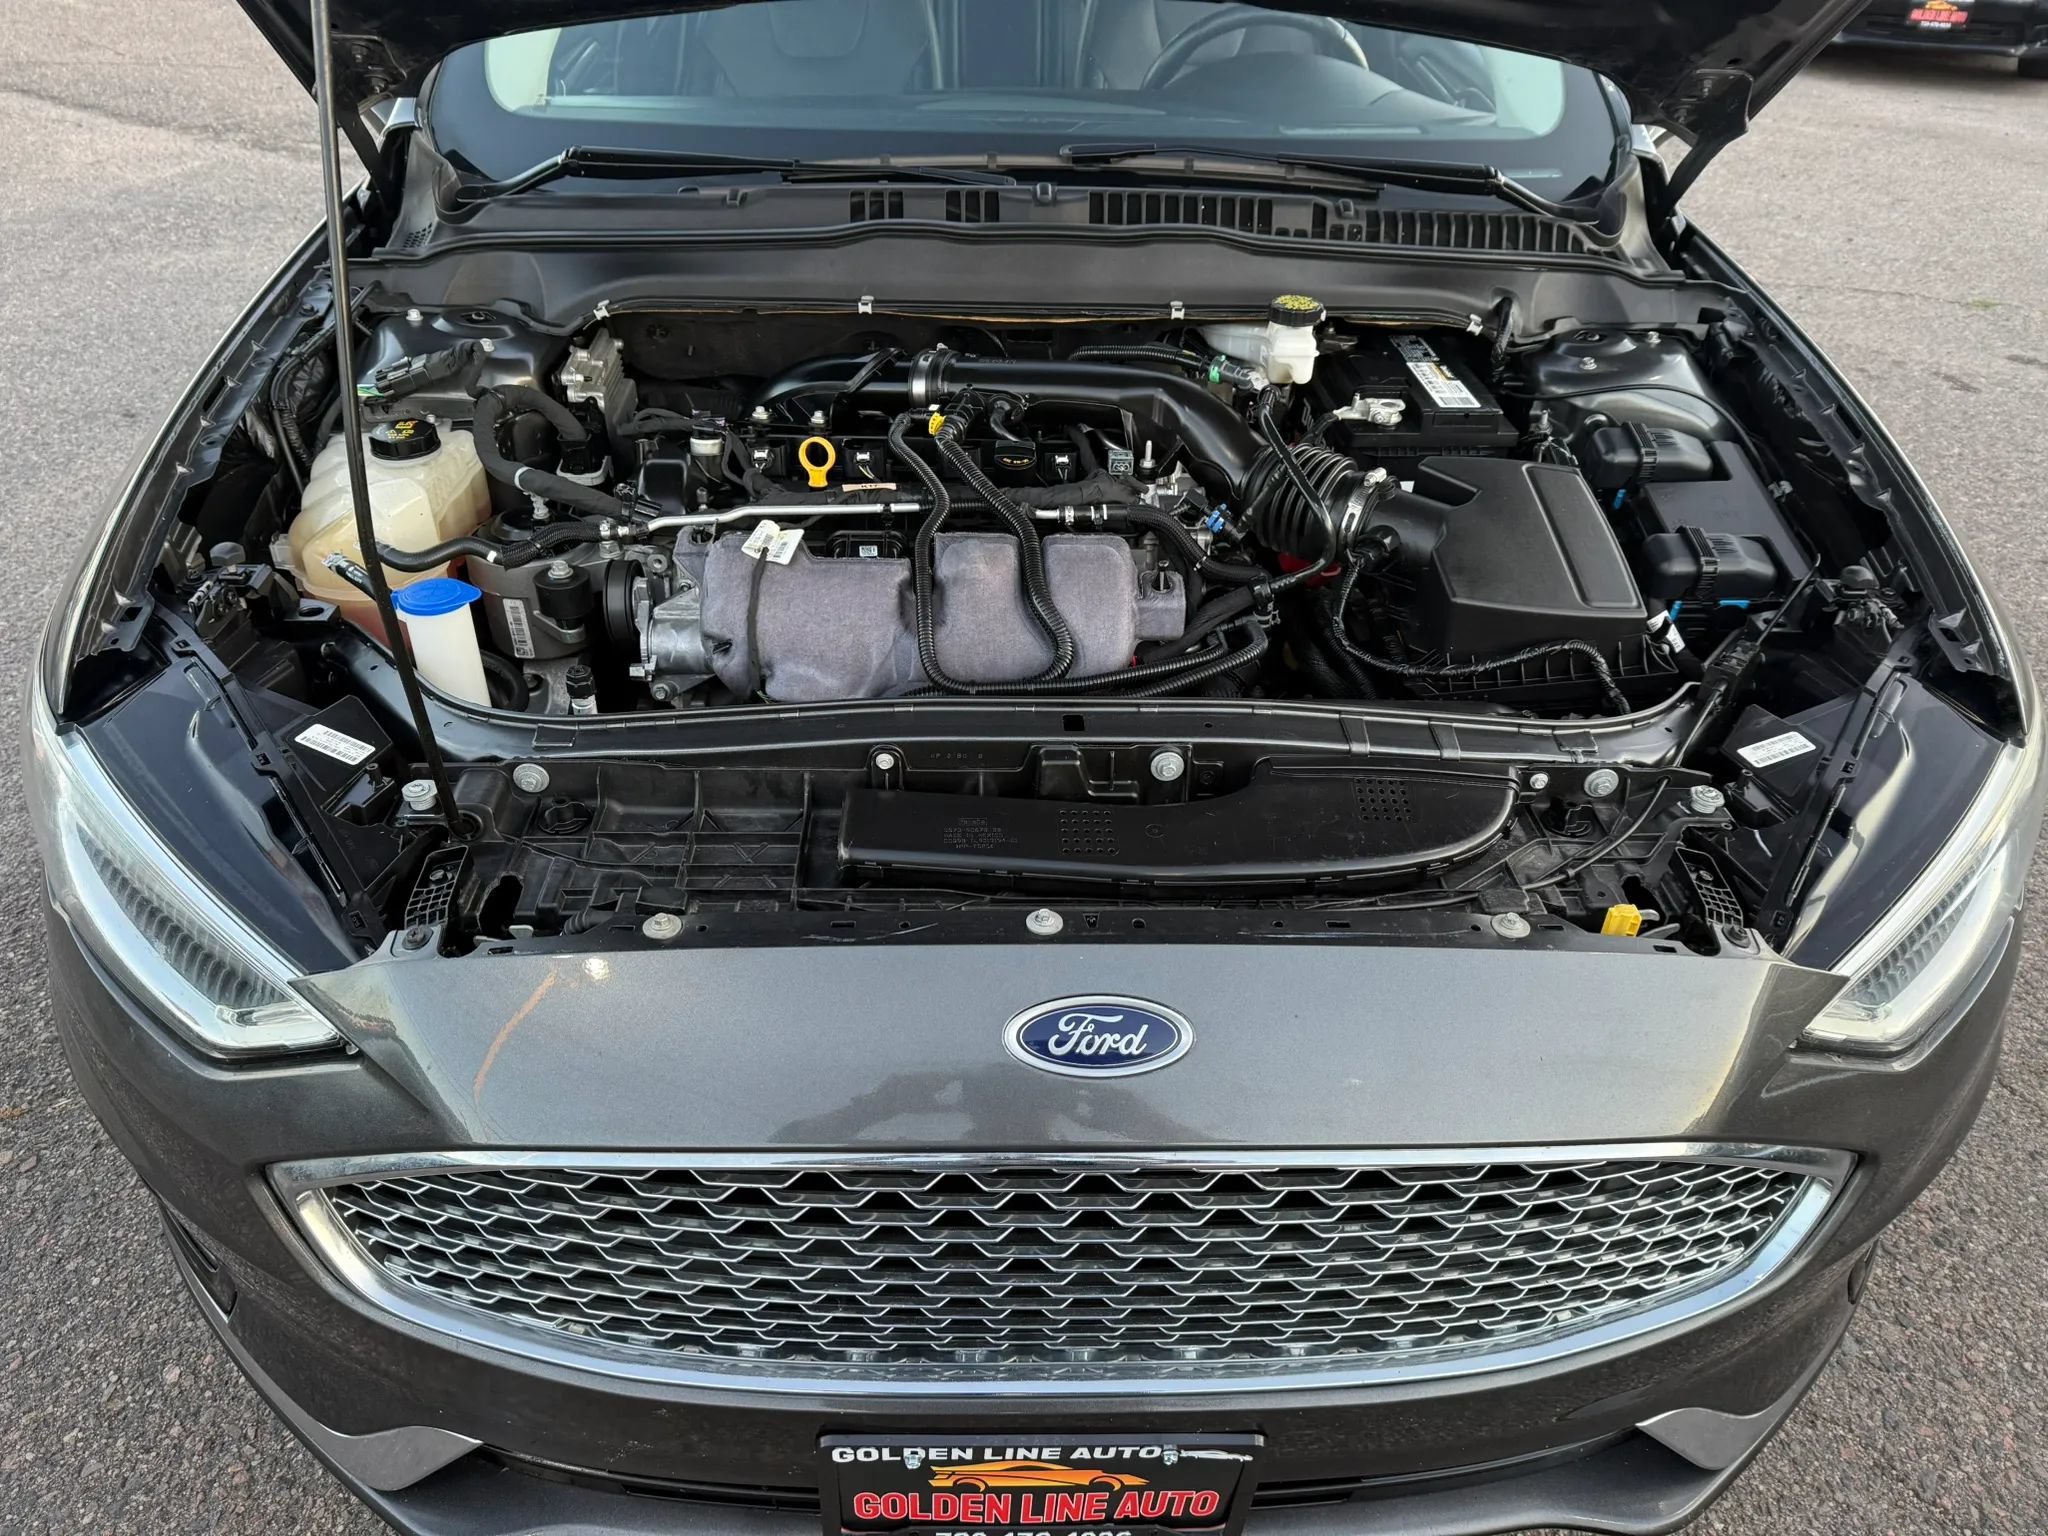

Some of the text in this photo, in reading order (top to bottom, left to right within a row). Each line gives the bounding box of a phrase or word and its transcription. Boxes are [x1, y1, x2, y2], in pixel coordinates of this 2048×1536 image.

[1048, 1013, 1149, 1056] Ford
[831, 1446, 1162, 1463] GOLDEN LINE AUTO
[853, 1489, 1220, 1525] GOLDEN LINE AUTO
